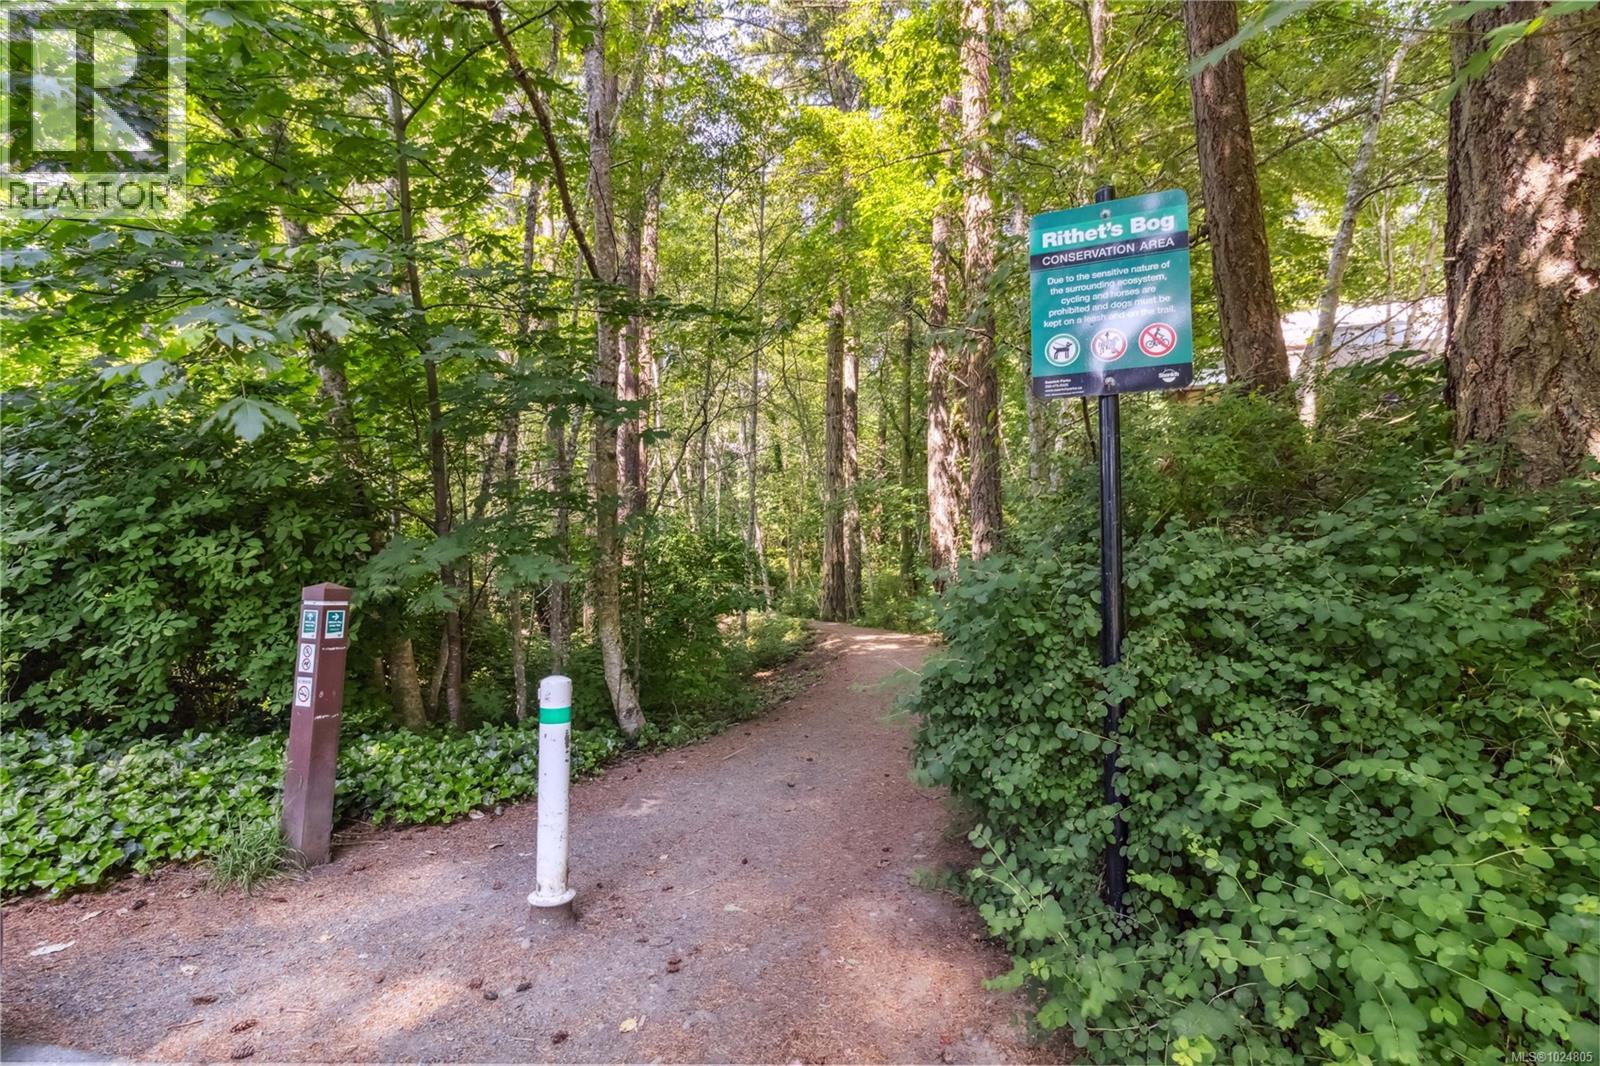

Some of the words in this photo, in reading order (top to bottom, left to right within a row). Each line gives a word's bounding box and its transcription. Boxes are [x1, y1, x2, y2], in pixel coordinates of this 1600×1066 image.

[1130, 215, 1175, 234] Bog
[1042, 242, 1135, 266] CONSERVATION
[1140, 237, 1175, 251] AREA
[1047, 276, 1064, 285] Due
[1066, 275, 1075, 283] to
[1076, 272, 1090, 281] the
[1091, 267, 1129, 279] sensitive
[1131, 262, 1159, 273] nature
[1161, 260, 1171, 268] of
[1050, 287, 1064, 295] the
[1065, 280, 1116, 295] surrounding
[1117, 272, 1168, 287] ecosystem,
[1048, 304, 1090, 318] prohibited
[1092, 301, 1108, 310] and
[1110, 299, 1132, 310] dogs
[1135, 296, 1156, 305] must
[1159, 294, 1171, 302] be
[1061, 293, 1090, 305] cycling
[1092, 291, 1108, 300] and
[1110, 287, 1139, 298] horses
[1142, 285, 1156, 294] are
[1043, 318, 1062, 328] kept
[1157, 304, 1176, 314] trail.
